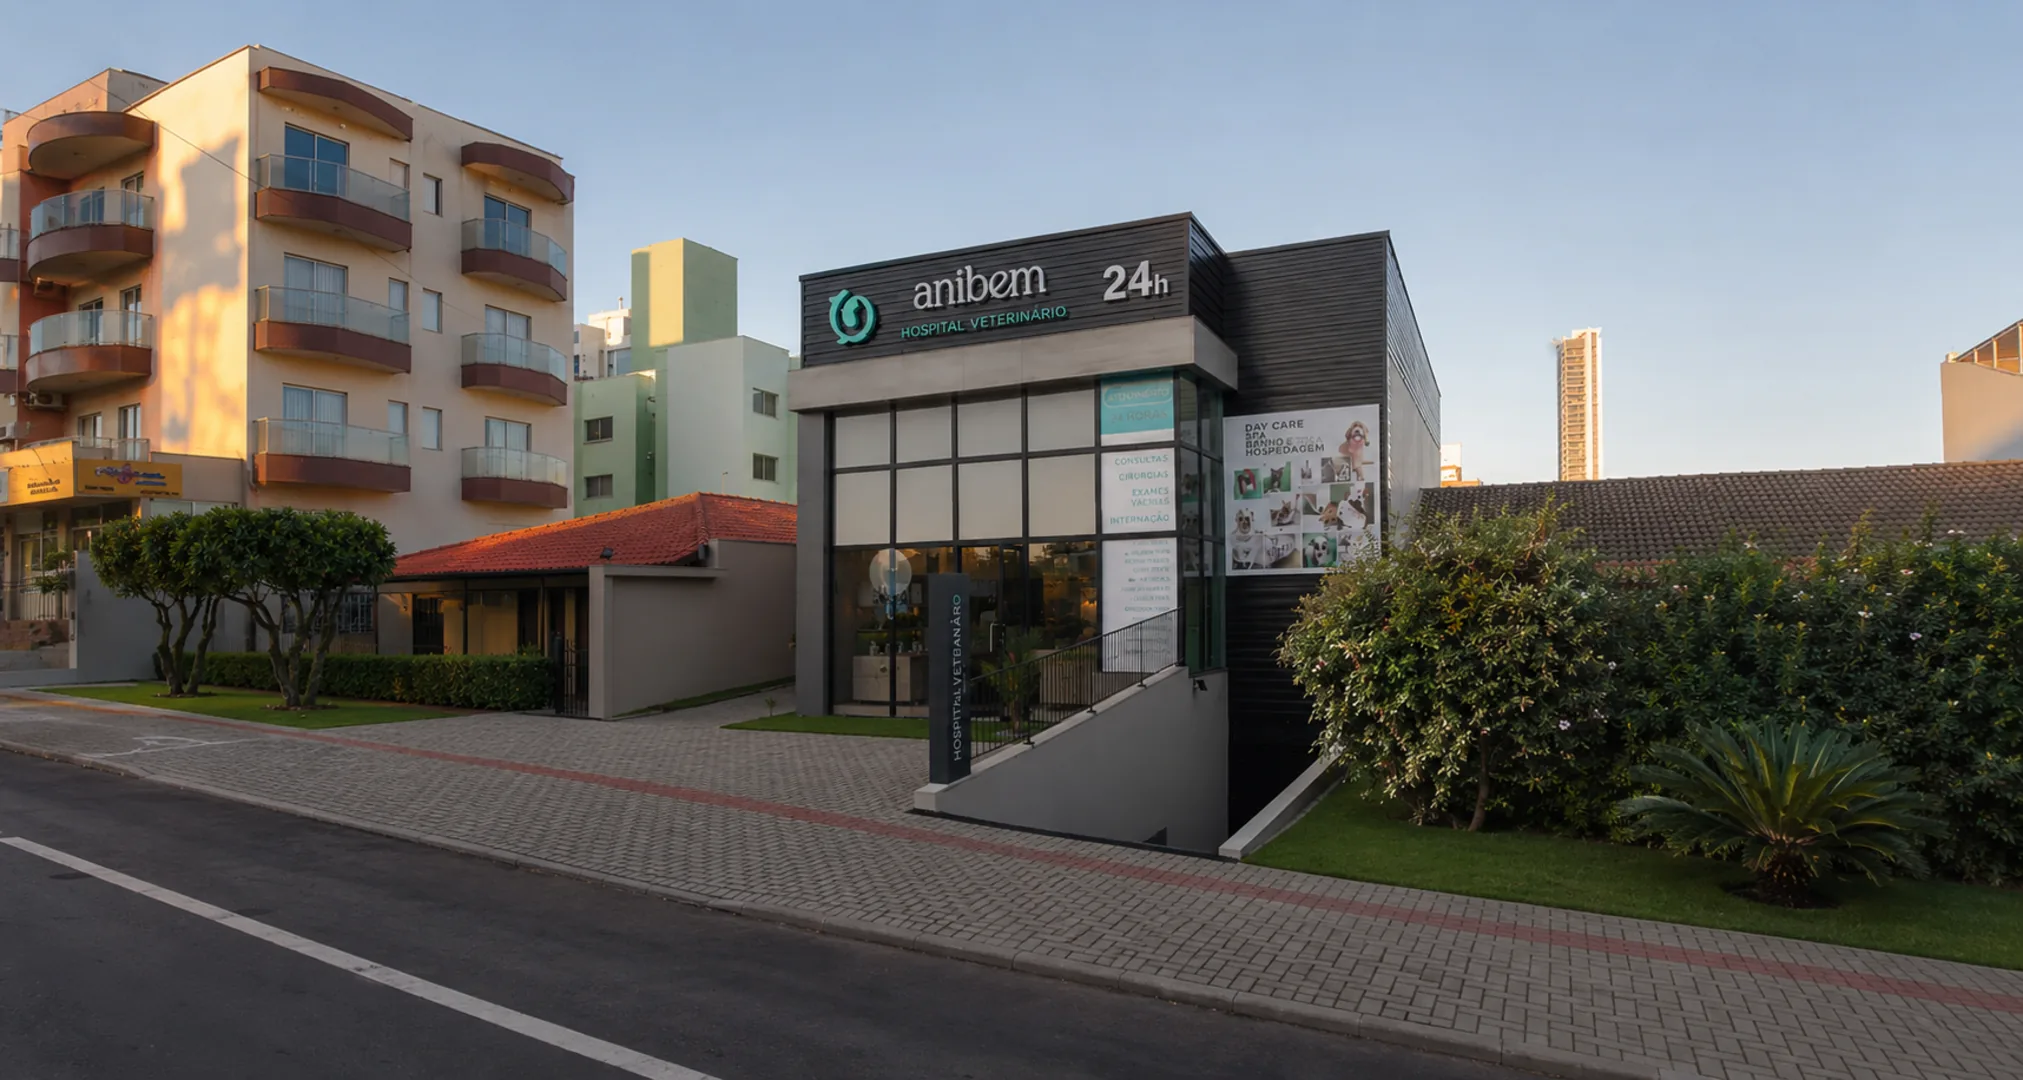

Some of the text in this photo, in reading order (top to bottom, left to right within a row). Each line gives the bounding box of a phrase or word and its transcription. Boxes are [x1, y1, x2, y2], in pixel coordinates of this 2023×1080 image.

[913, 265, 1047, 310] anibem
[1102, 260, 1169, 302] 24h
[901, 304, 1067, 339] HOSPITAL VETERINÁRIO
[1245, 419, 1304, 432] DAY CARE
[1245, 444, 1325, 457] HOSPEDAGEM
[1115, 454, 1168, 466] CONSULTAS
[1110, 510, 1169, 525] INTERNAÇÃO
